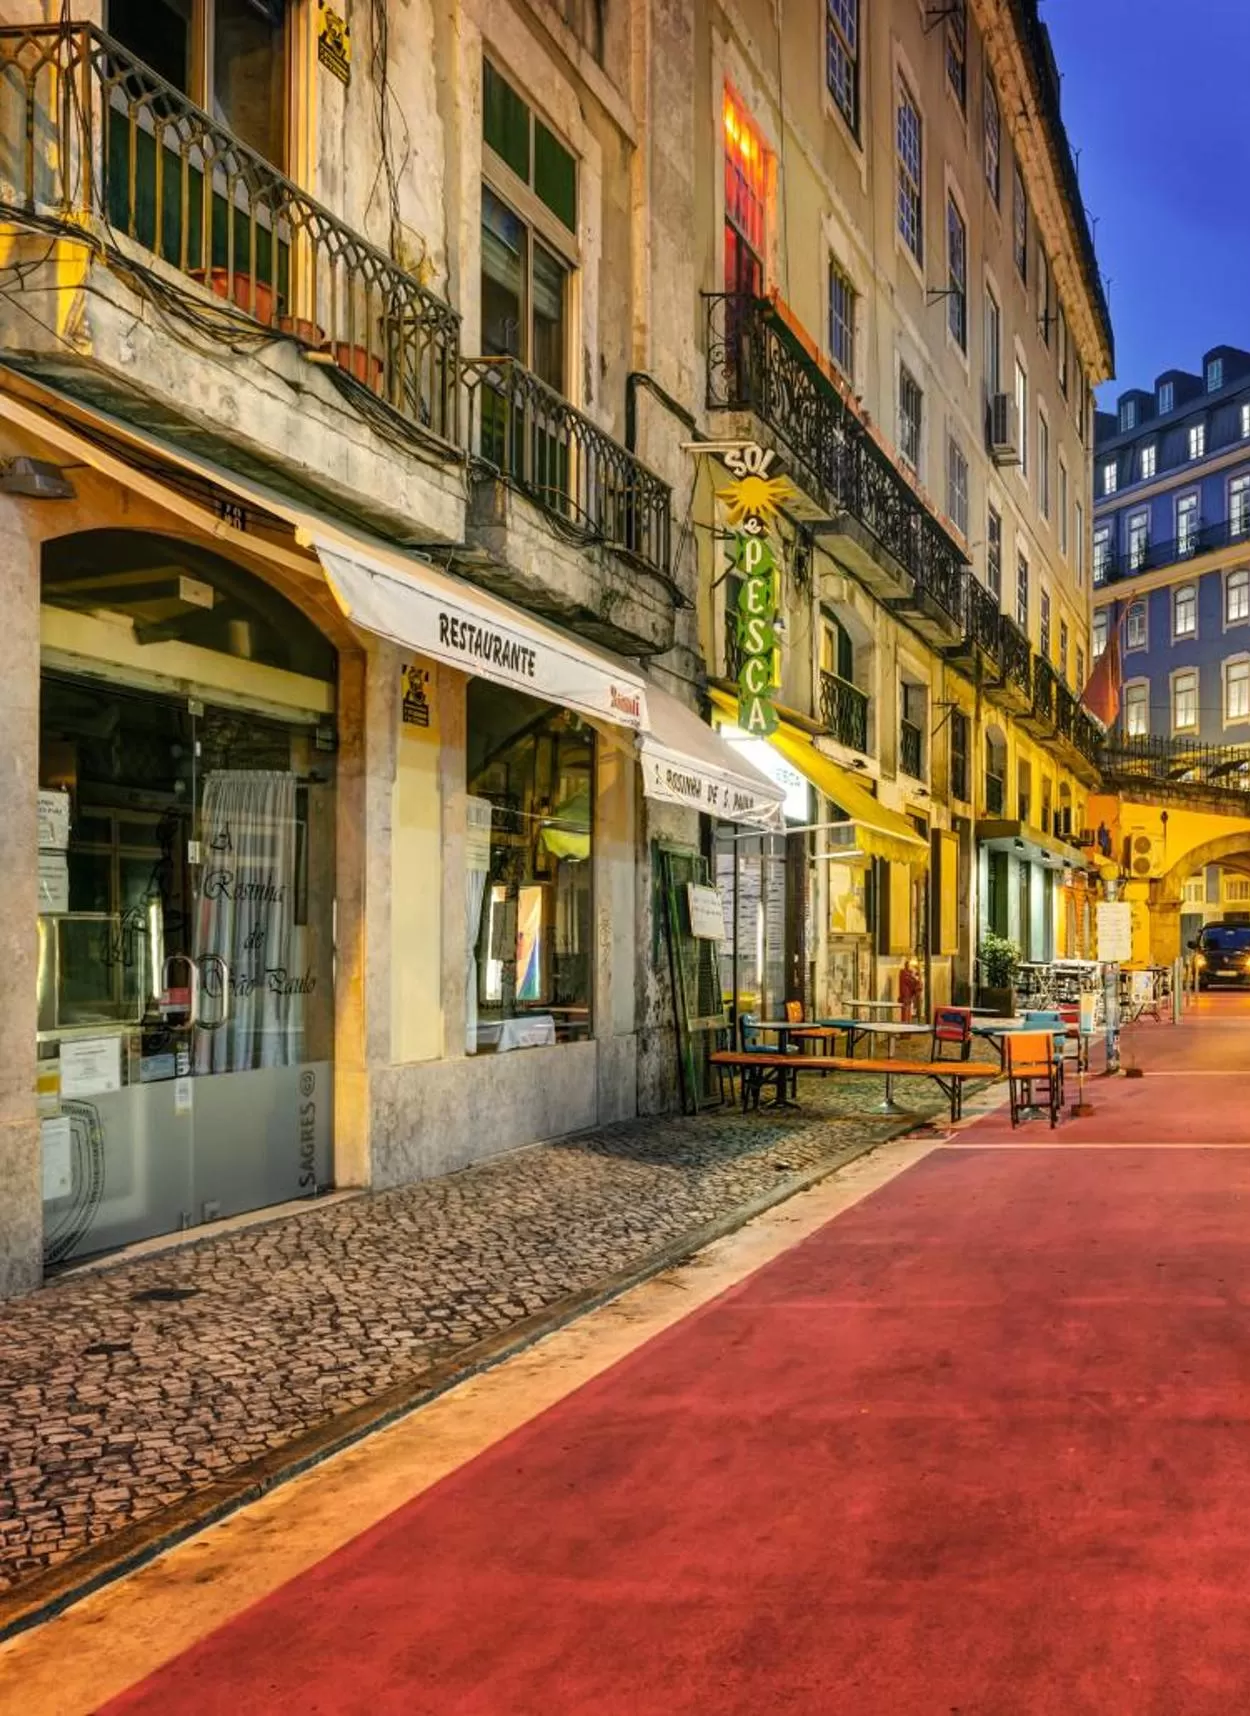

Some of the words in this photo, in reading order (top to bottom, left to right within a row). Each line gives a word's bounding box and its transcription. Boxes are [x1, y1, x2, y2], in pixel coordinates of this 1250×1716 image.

[724, 445, 775, 479] SOL
[743, 518, 762, 534] e
[439, 612, 536, 677] RESTAURANTE
[744, 538, 767, 731] PESCA
[707, 784, 719, 804] DE
[264, 963, 318, 996] Paulo
[299, 1101, 316, 1188] SAGRES
